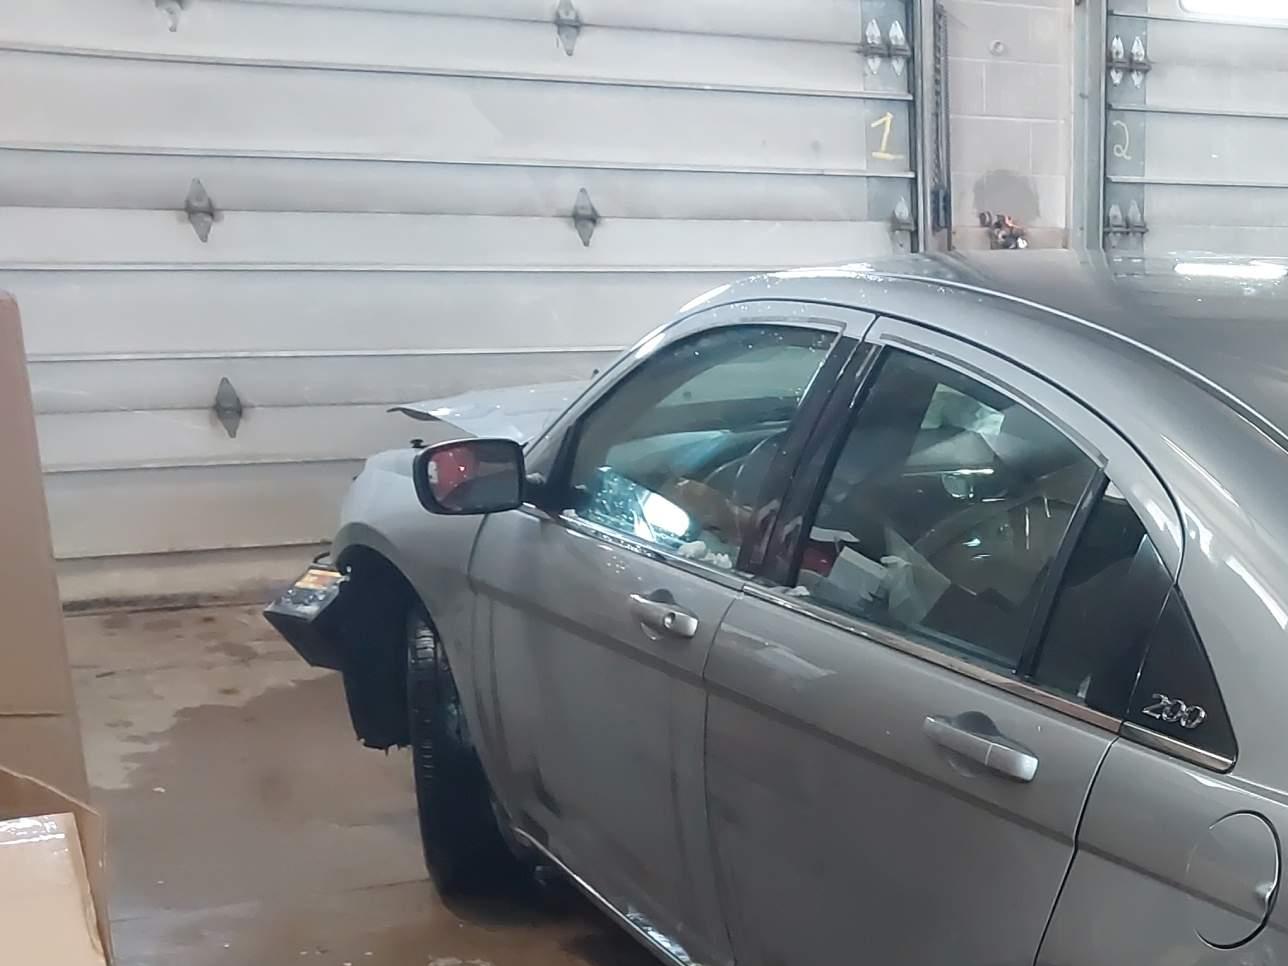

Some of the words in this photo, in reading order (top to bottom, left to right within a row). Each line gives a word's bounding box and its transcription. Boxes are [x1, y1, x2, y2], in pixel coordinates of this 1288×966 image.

[871, 111, 905, 160] 1
[1112, 119, 1132, 161] 2
[1142, 693, 1206, 729] 200
